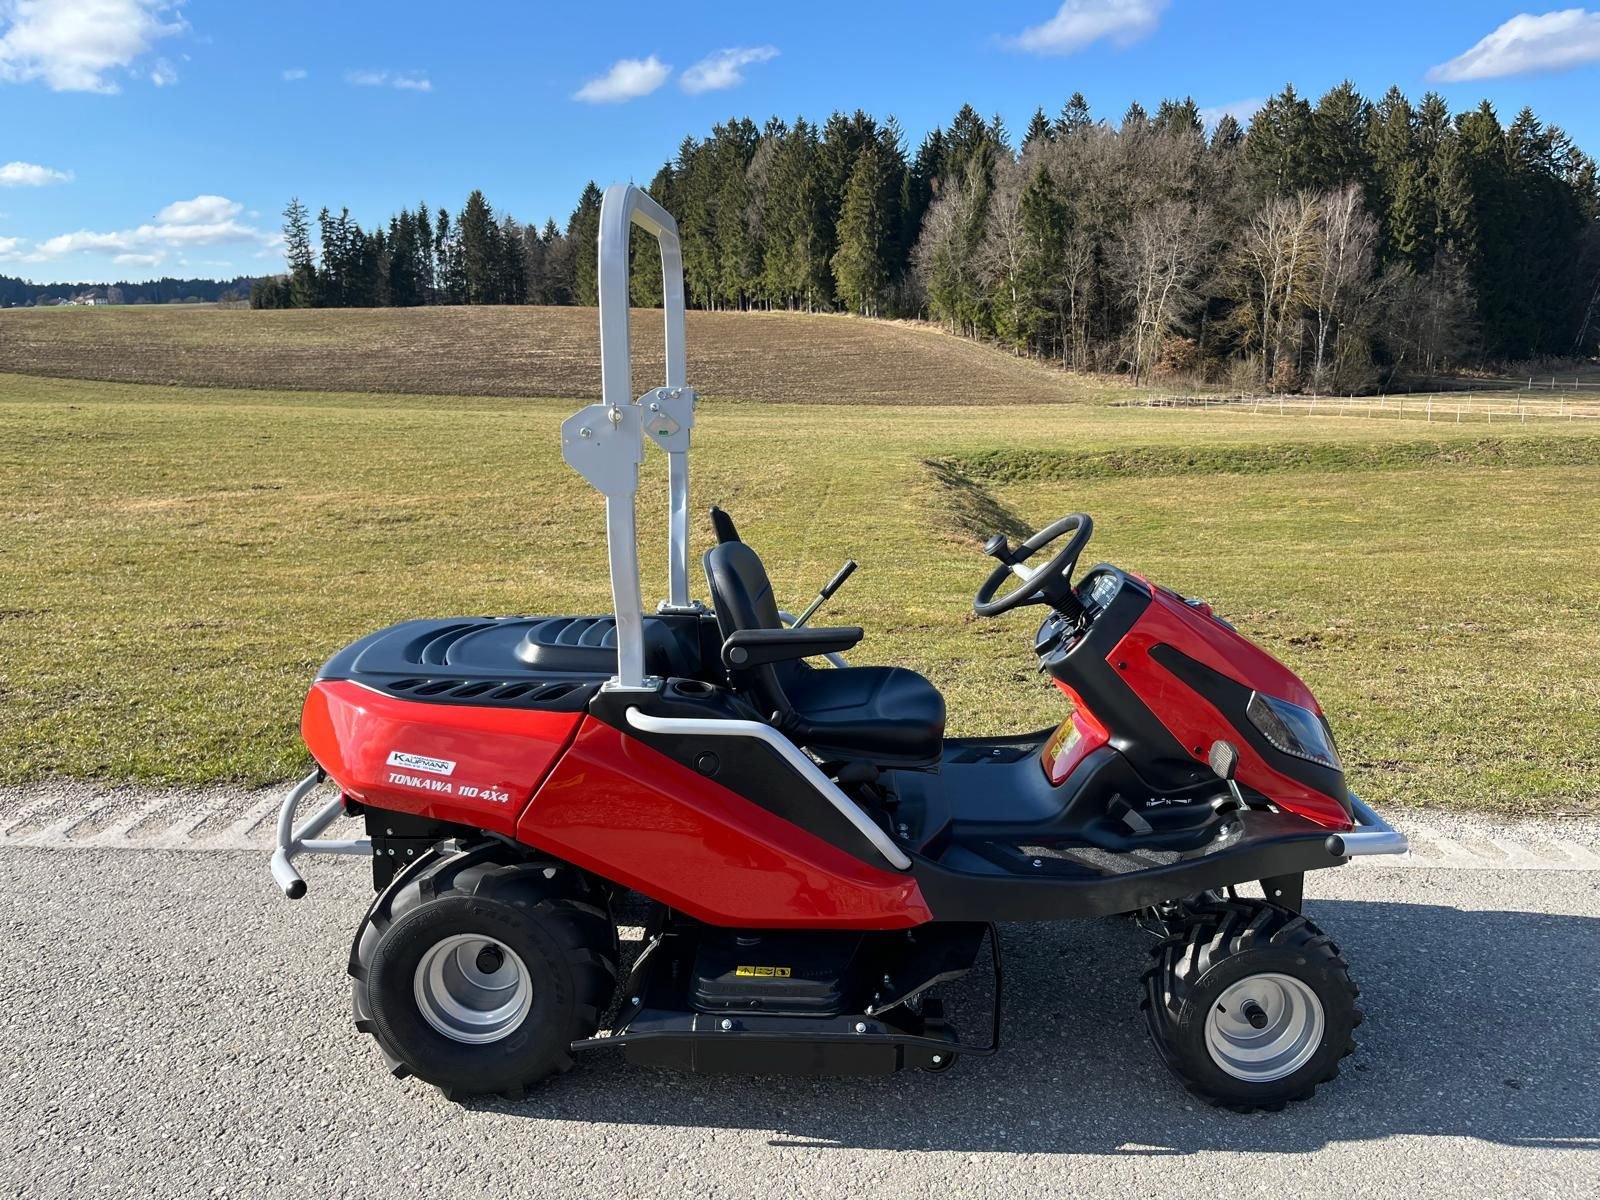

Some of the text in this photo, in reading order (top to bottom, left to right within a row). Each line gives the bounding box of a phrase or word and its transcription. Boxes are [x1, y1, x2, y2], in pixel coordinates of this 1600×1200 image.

[388, 773, 509, 802] TONKAWA 110 4X4
